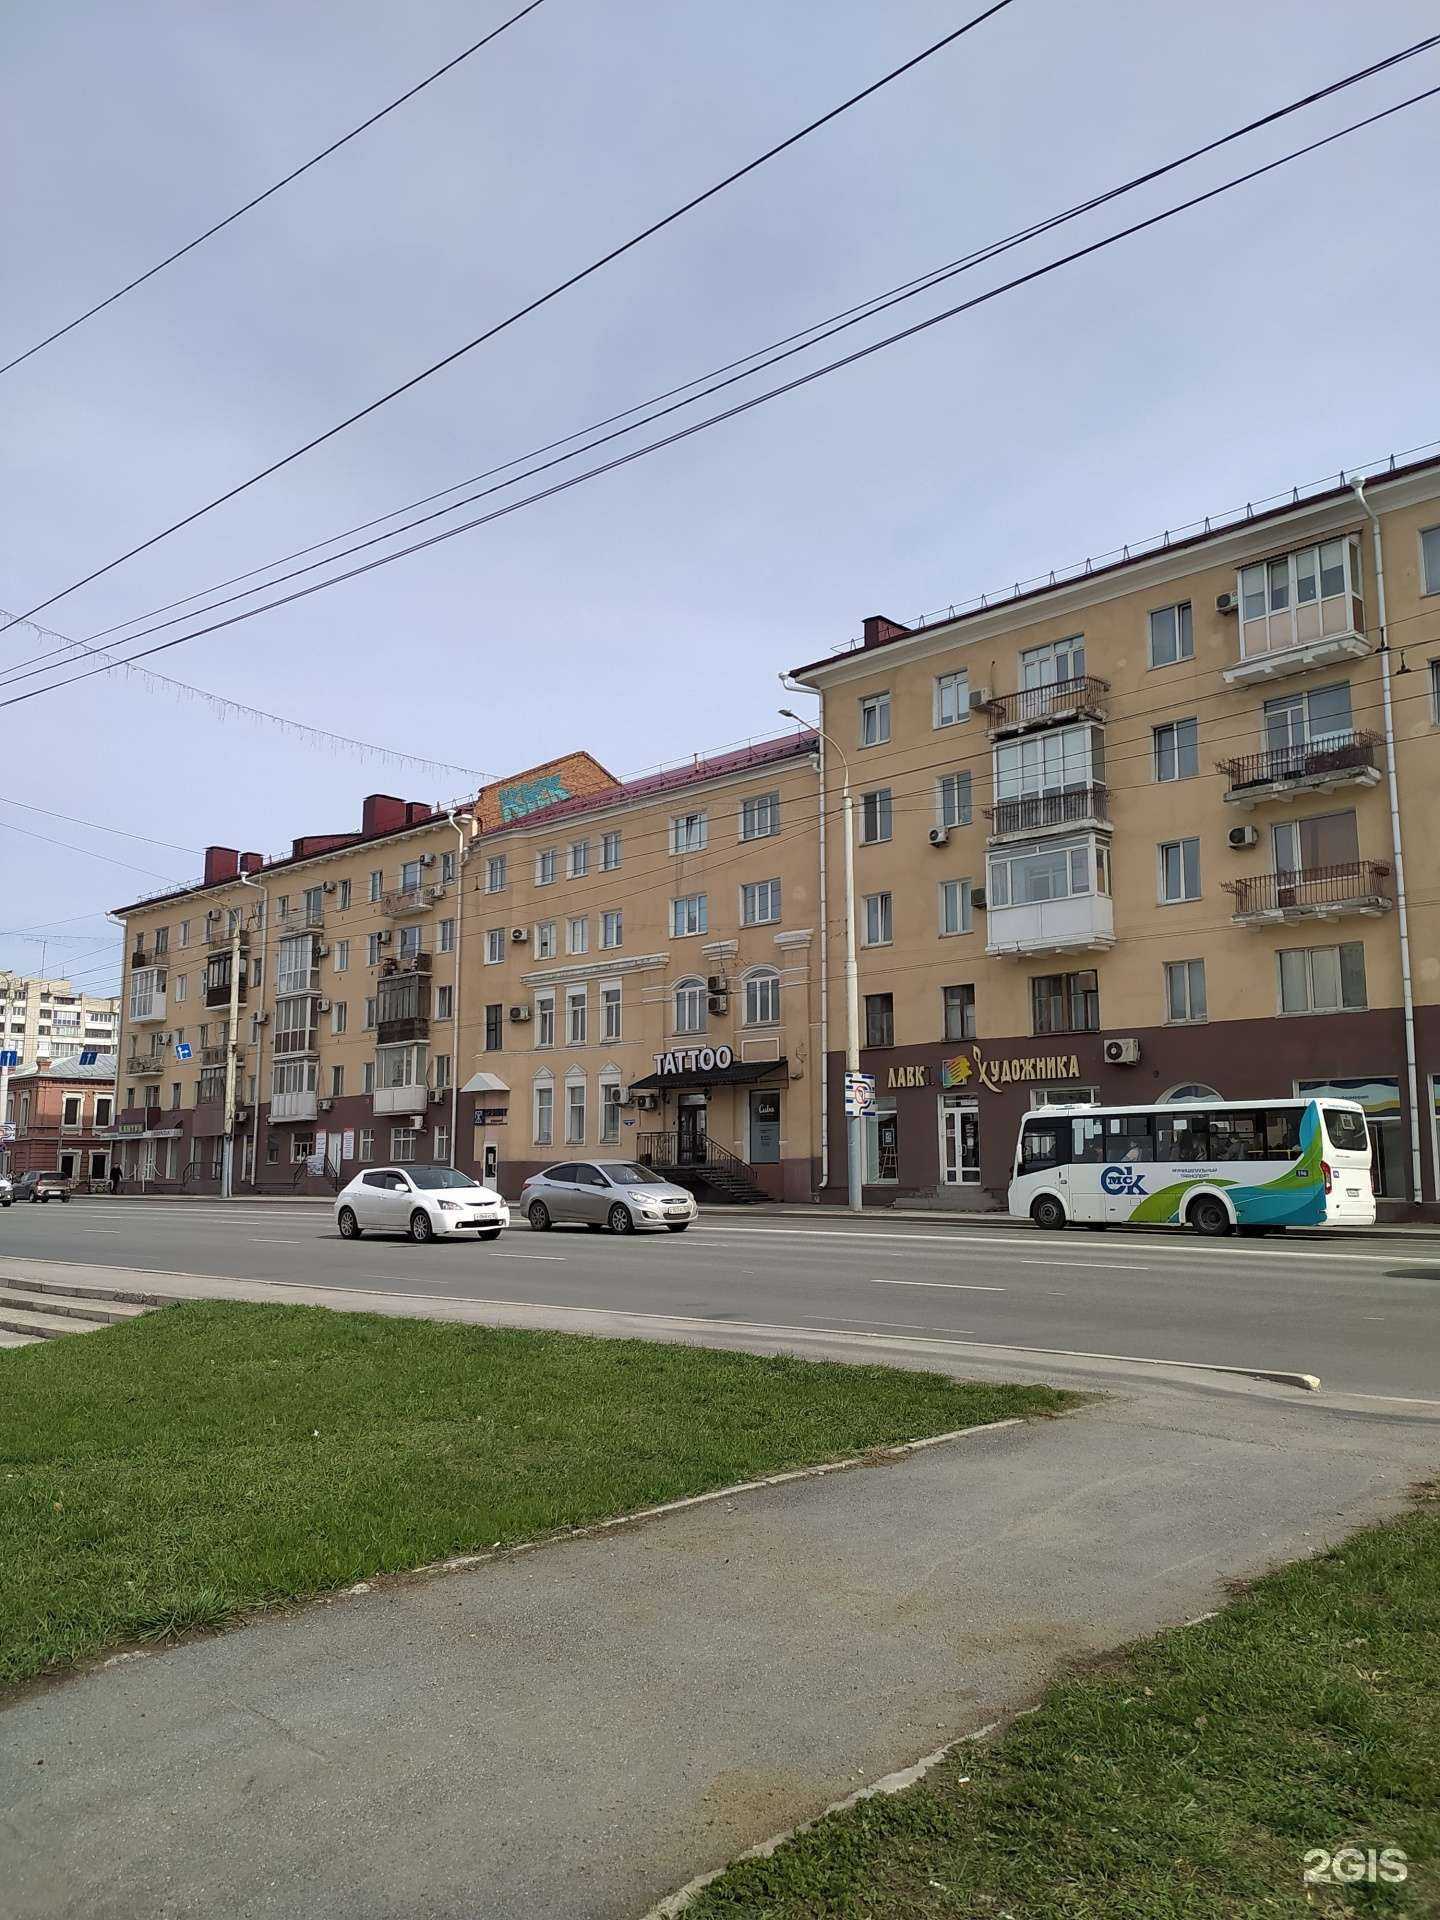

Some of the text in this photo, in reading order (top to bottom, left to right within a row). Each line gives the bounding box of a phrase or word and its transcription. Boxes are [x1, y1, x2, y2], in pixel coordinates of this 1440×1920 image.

[653, 1046, 732, 1076] TATTOO
[887, 1045, 1080, 1093] ЛАВК ХУДОЖНИКА
